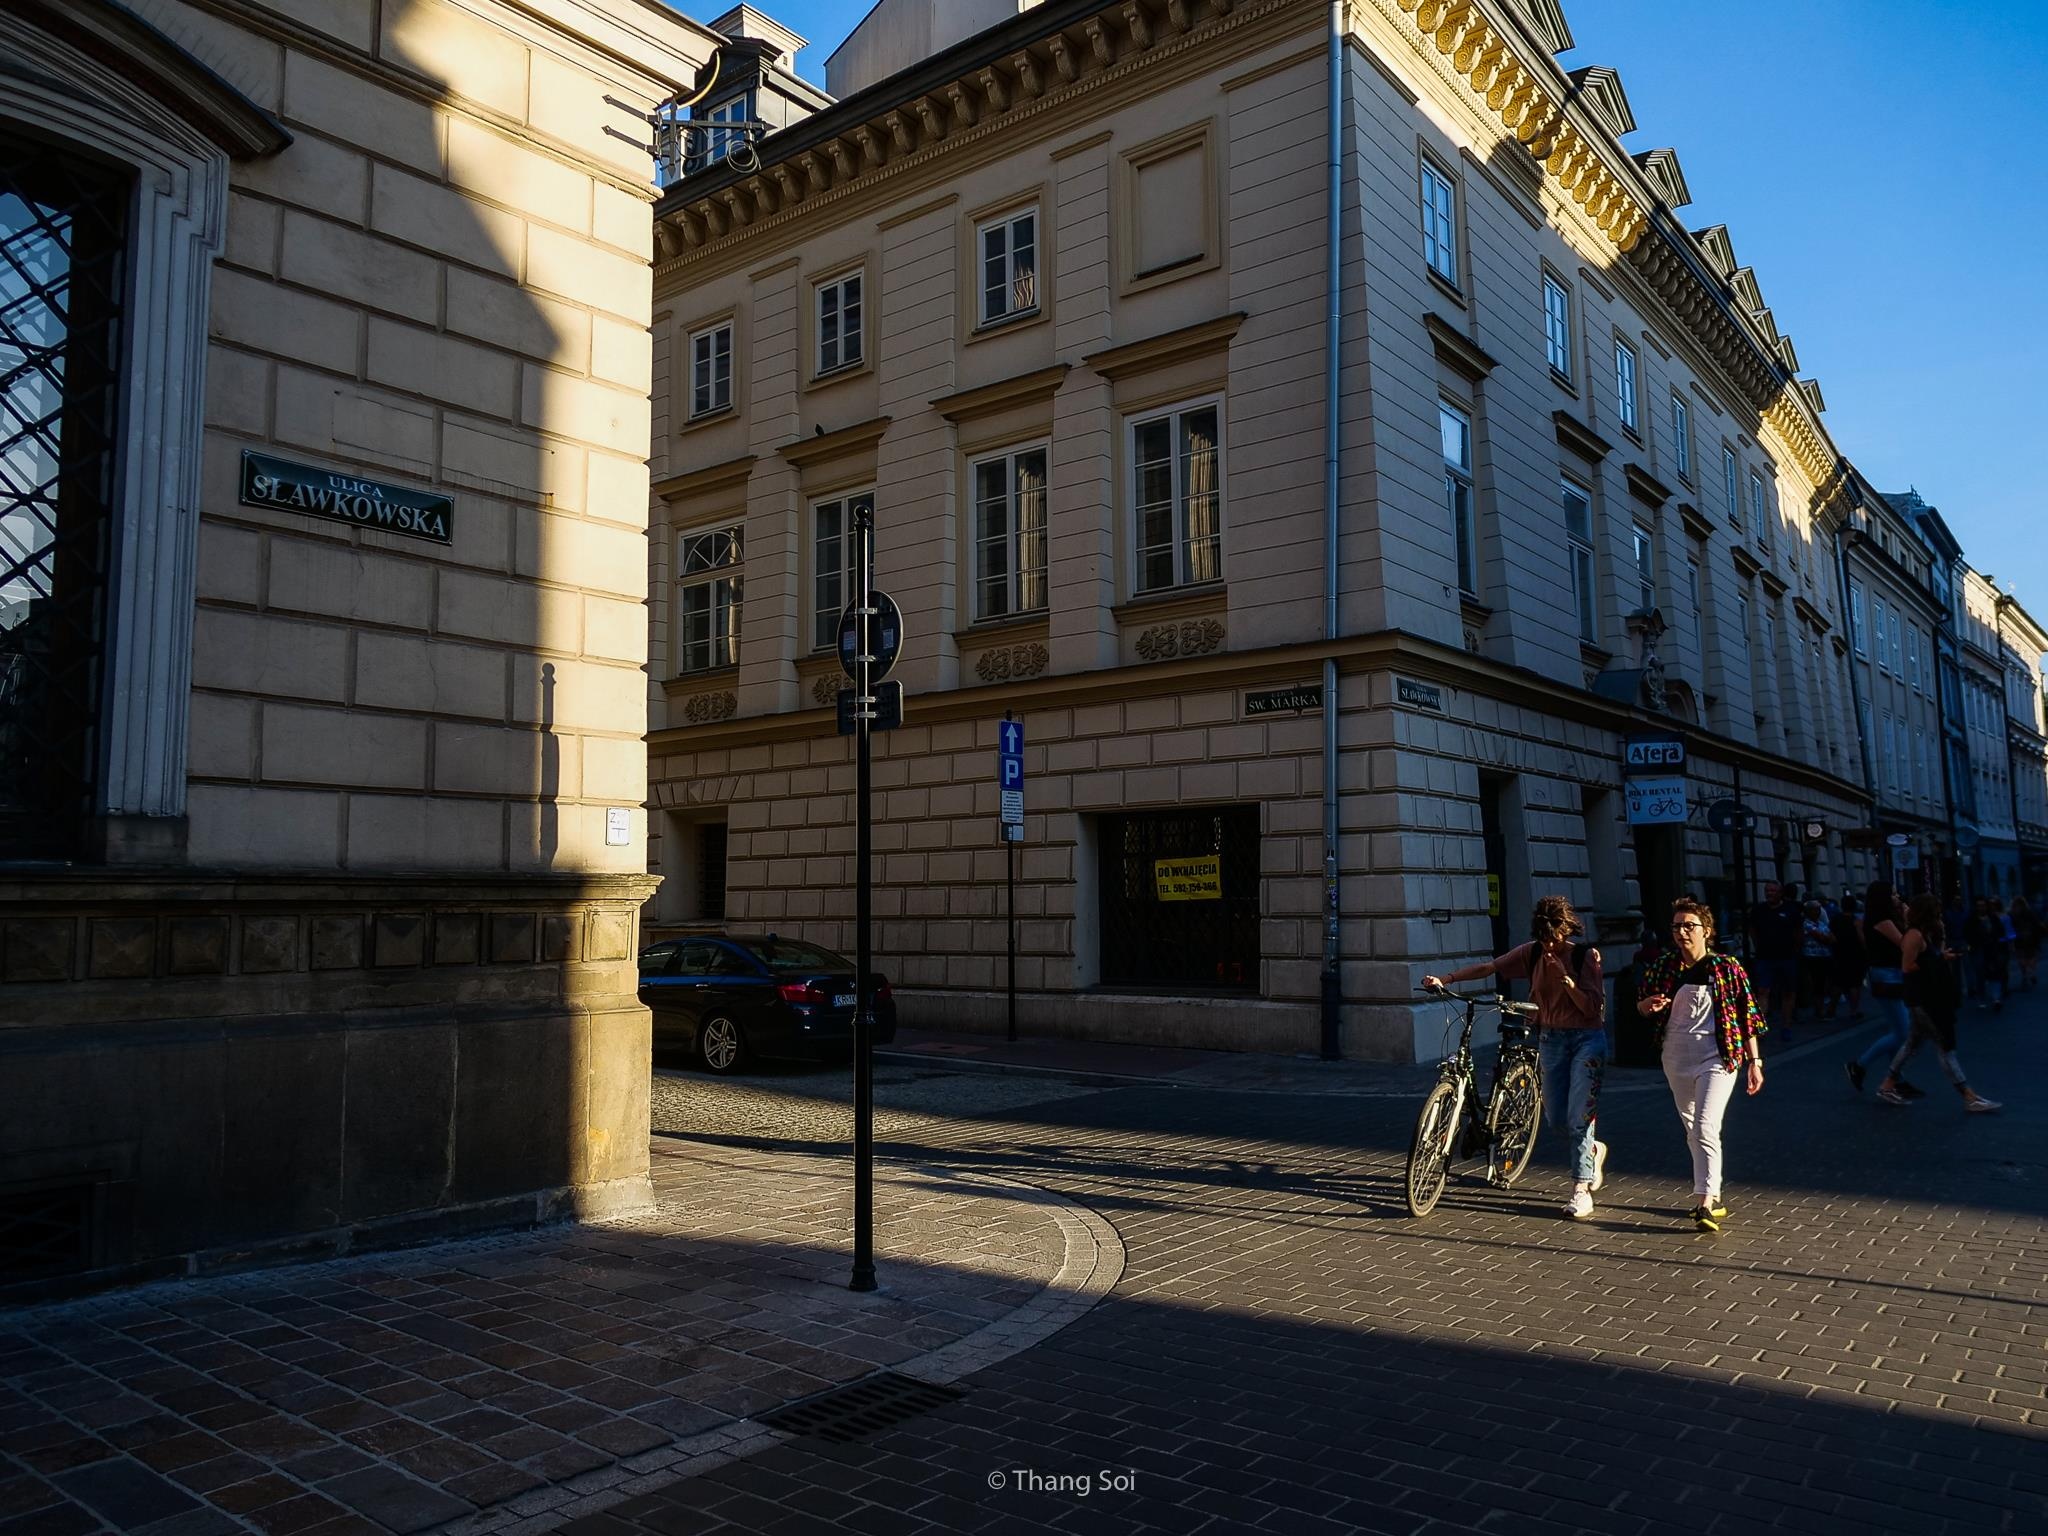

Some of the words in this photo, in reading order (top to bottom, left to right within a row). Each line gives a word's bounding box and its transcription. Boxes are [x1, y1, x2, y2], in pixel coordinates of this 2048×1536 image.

[328, 475, 384, 498] ULICA
[252, 474, 446, 537] SŁAWKOWSKA
[1271, 695, 1319, 709] MARKA
[1631, 746, 1680, 765] Afera
[1006, 759, 1019, 785] P
[1649, 787, 1683, 796] RENTAL
[1158, 867, 1169, 877] DO
[1171, 864, 1217, 877] WYNAJĘCIA
